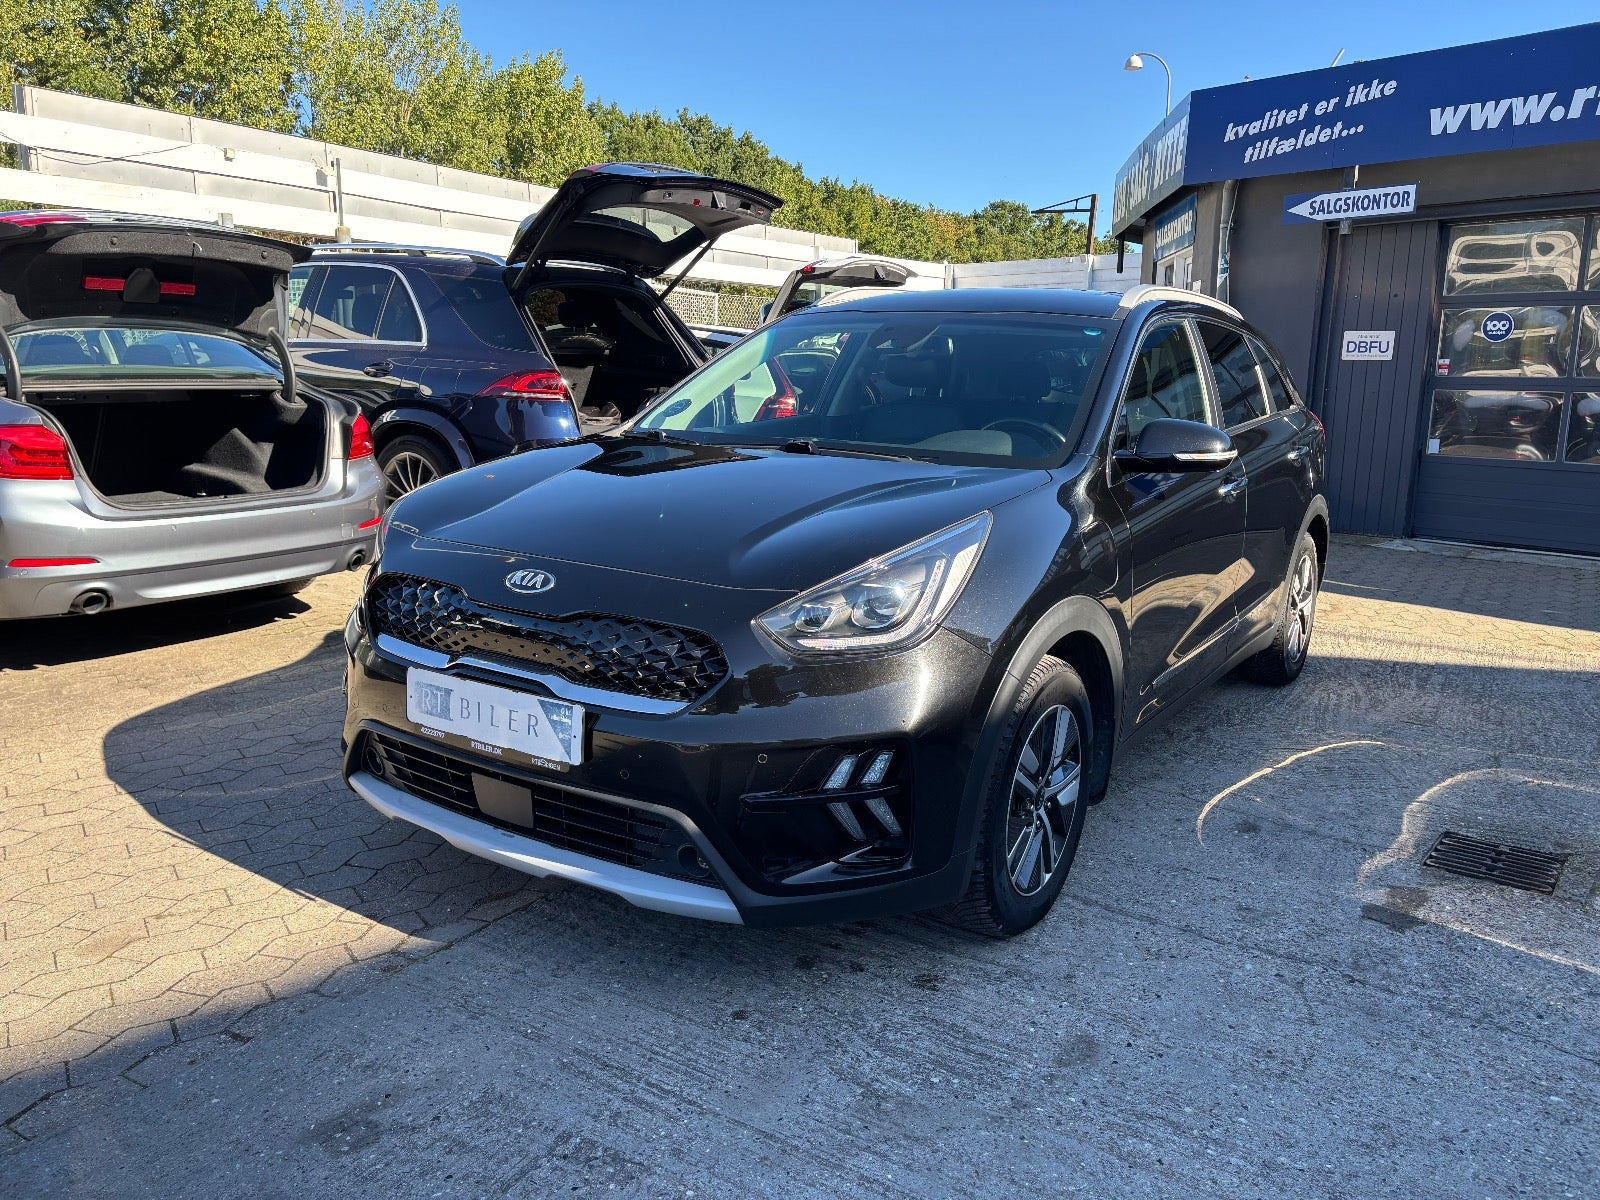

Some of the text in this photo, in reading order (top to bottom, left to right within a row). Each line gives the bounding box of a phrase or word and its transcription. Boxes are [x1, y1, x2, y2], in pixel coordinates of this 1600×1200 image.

[1223, 78, 1397, 142] kvalitet er ikke
[1430, 85, 1600, 136] www.r
[1153, 114, 1188, 190] BYTTE
[1243, 121, 1364, 164] tilfældet...
[1308, 191, 1411, 216] SALGSKONTOR
[1346, 341, 1390, 353] DBFU
[510, 571, 545, 589] KIA
[422, 687, 539, 738] RT BILER
